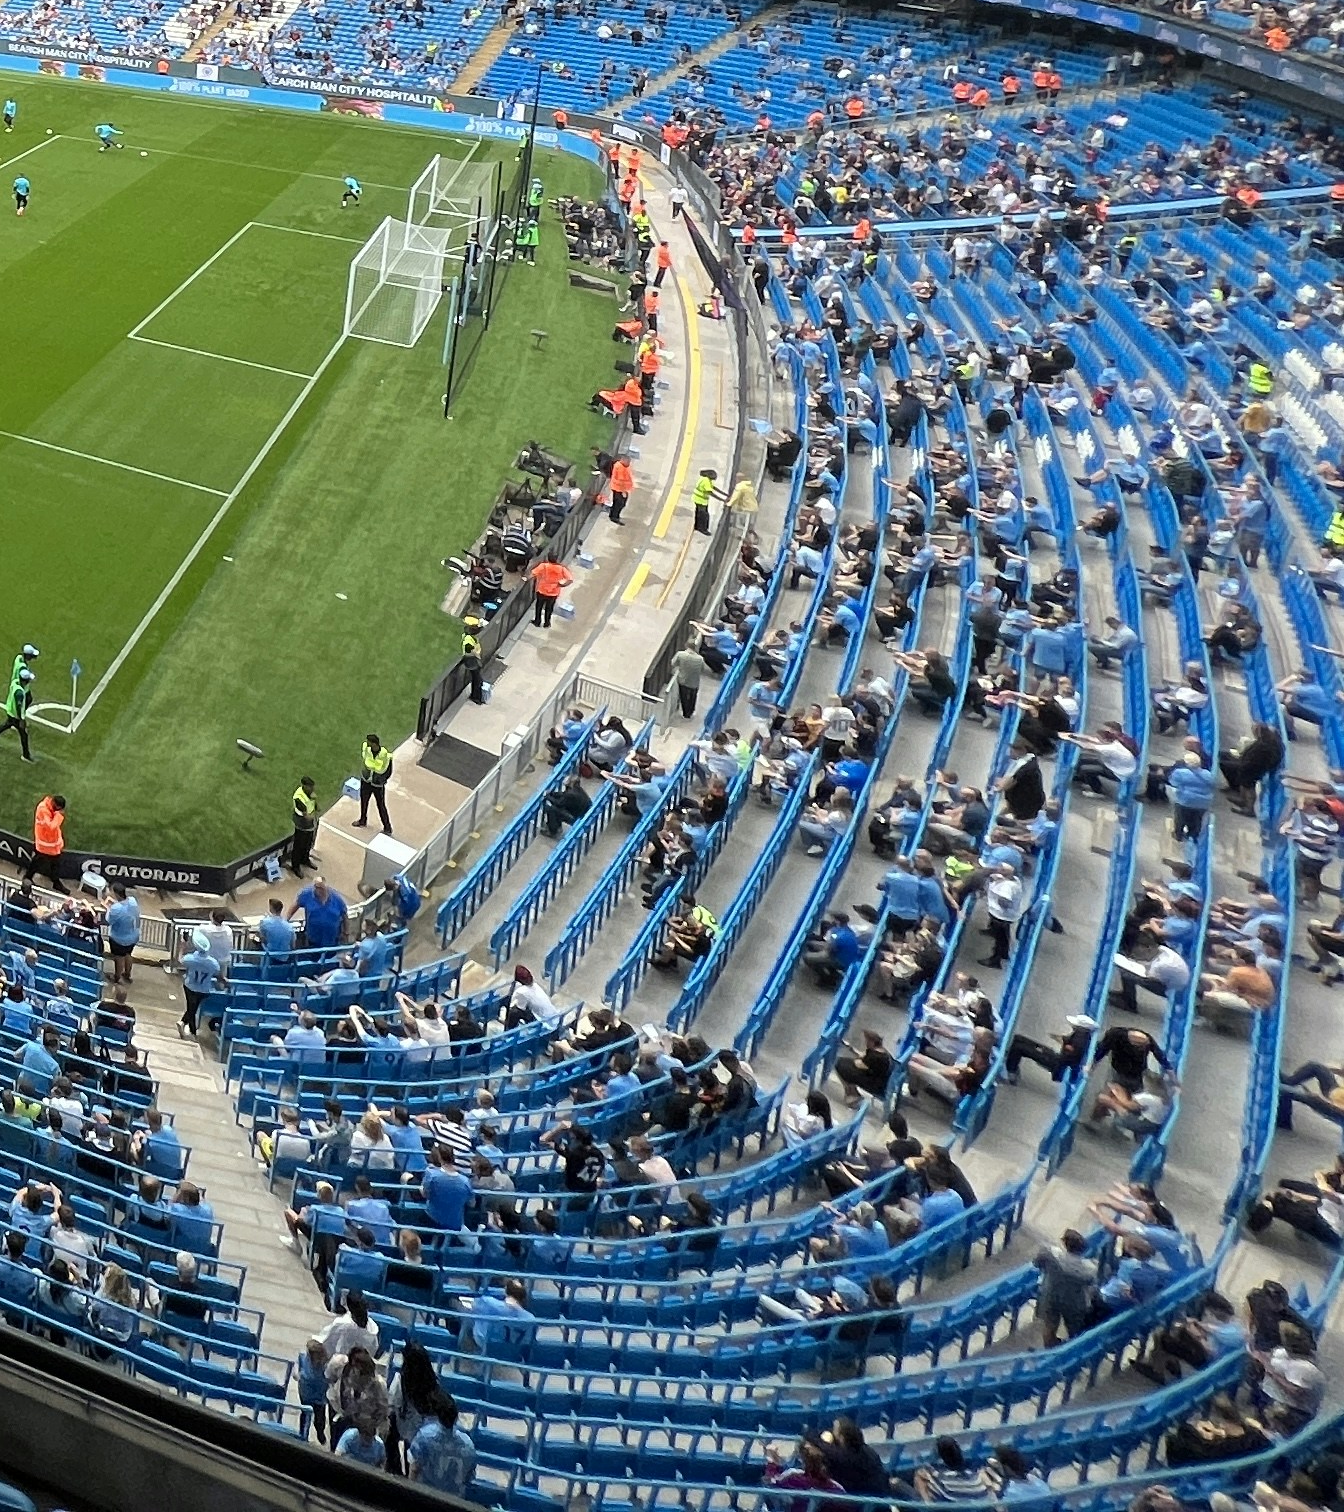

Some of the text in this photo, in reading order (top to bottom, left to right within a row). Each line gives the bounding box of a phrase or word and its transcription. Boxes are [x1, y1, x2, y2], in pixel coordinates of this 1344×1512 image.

[9, 43, 44, 56] SEARCH
[45, 47, 67, 58] MAN
[68, 50, 89, 61] CITY
[310, 80, 337, 93] MAN
[338, 83, 366, 96] CITY
[474, 119, 503, 134] 100%
[105, 865, 200, 886] GATORADE
